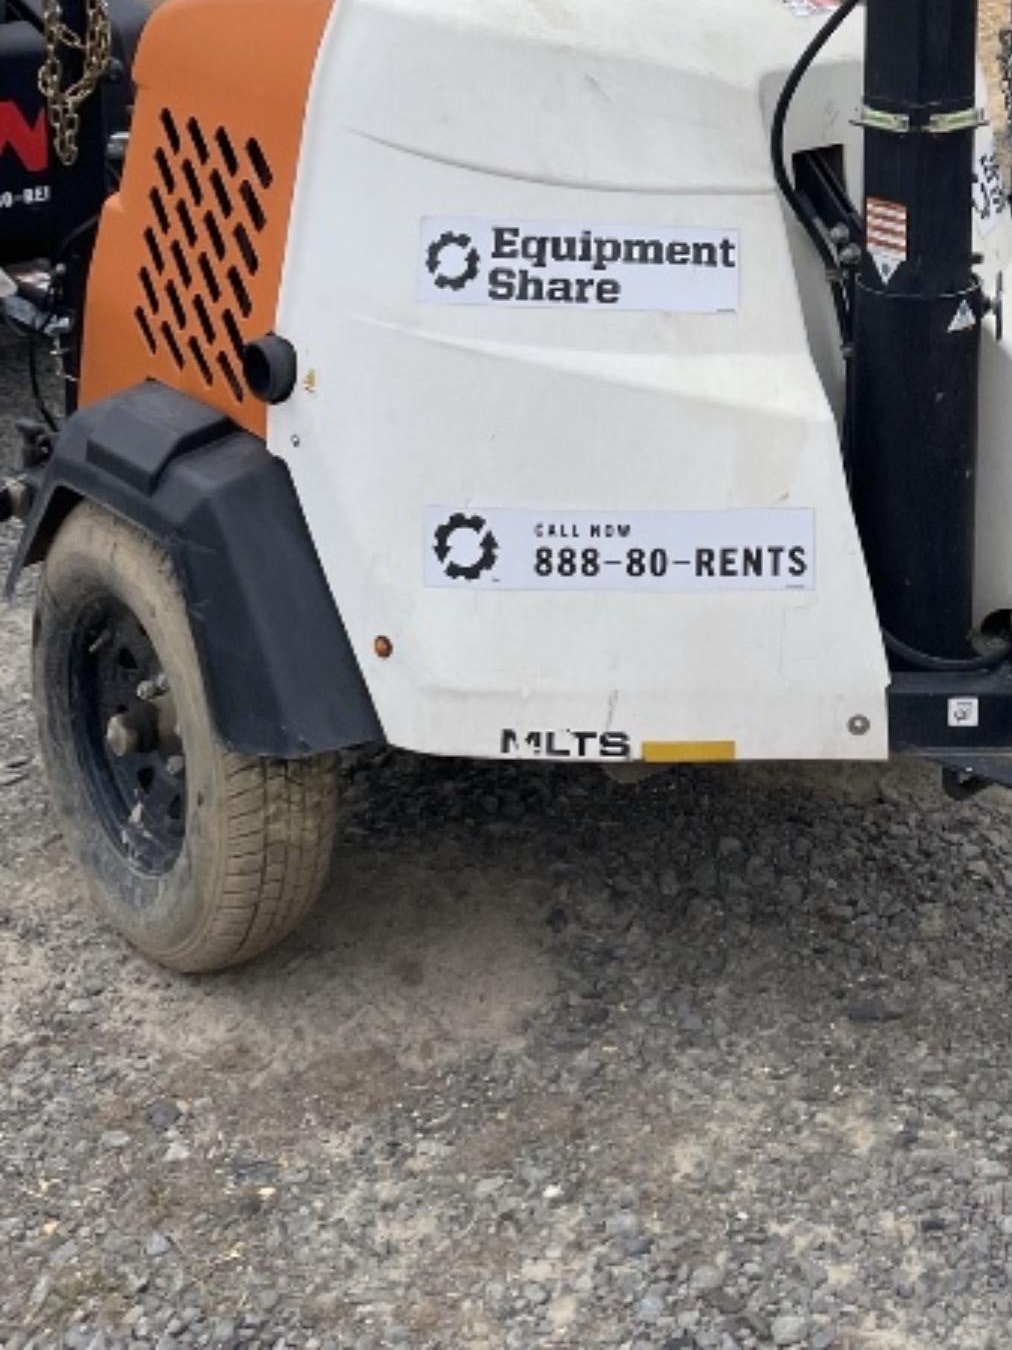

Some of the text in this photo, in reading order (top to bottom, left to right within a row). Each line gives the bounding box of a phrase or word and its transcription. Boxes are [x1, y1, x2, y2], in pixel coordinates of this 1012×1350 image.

[490, 226, 737, 271] Equipment
[487, 266, 622, 304] Share
[533, 523, 632, 538] CALL NOW
[533, 546, 808, 578] 888-80-RENTS
[499, 728, 631, 757] MLTS
